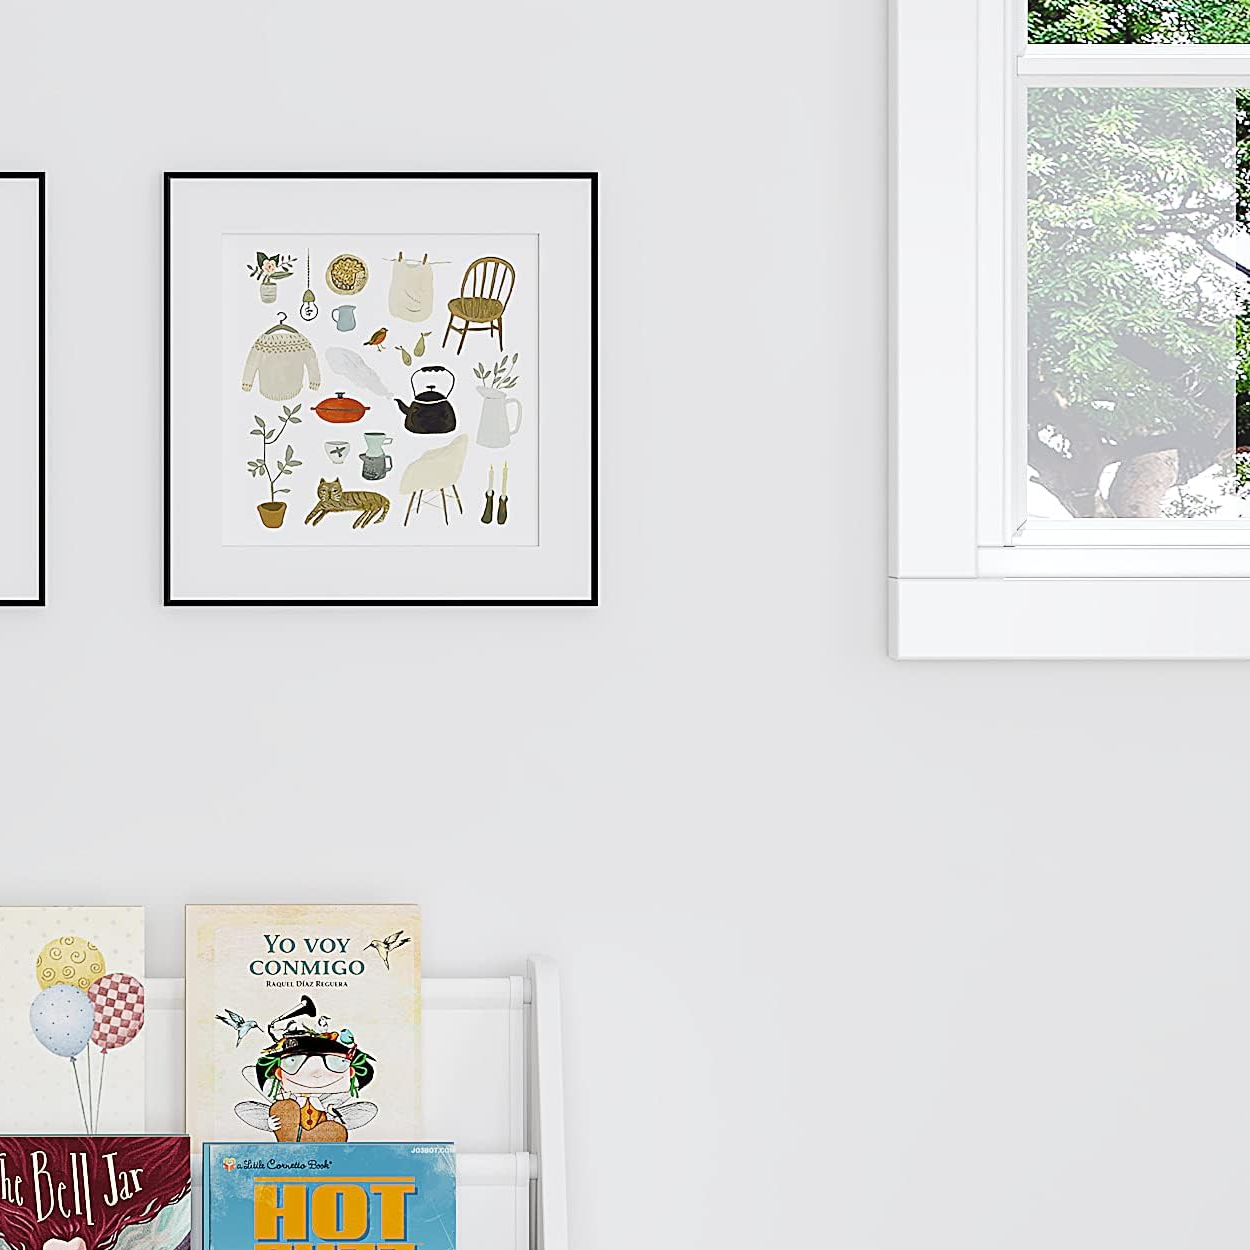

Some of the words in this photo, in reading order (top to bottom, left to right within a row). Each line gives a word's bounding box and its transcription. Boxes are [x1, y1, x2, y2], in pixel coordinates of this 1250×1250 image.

[249, 960, 365, 976] CONMIGO
[243, 1159, 265, 1169] Little
[267, 1158, 307, 1170] Cornetto
[30, 1151, 95, 1225] Bell
[102, 1152, 144, 1206] Jar
[254, 1184, 418, 1242] HOT
